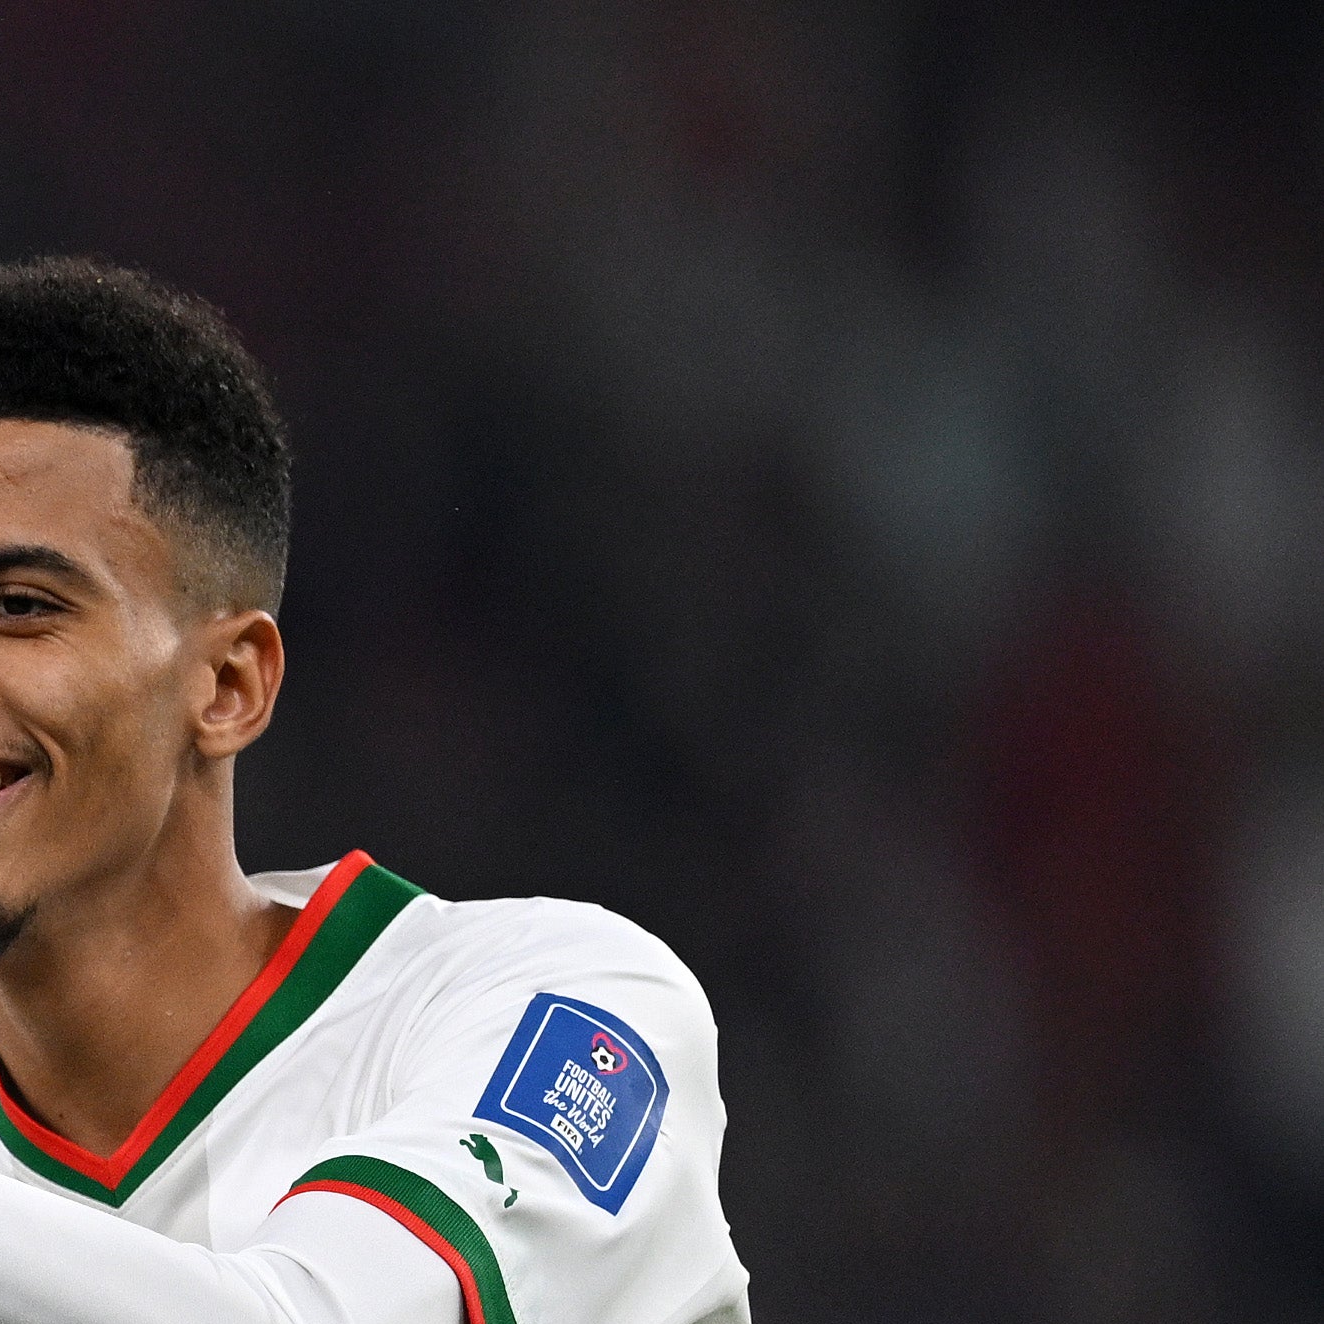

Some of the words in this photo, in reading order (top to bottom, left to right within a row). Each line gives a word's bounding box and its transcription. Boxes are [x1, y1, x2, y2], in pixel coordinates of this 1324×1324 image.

[555, 1072, 611, 1130] UNITES
[562, 1059, 617, 1114] FOOTBALL
[543, 1090, 568, 1111] the
[567, 1103, 605, 1149] World
[557, 1120, 578, 1144] FIFA
